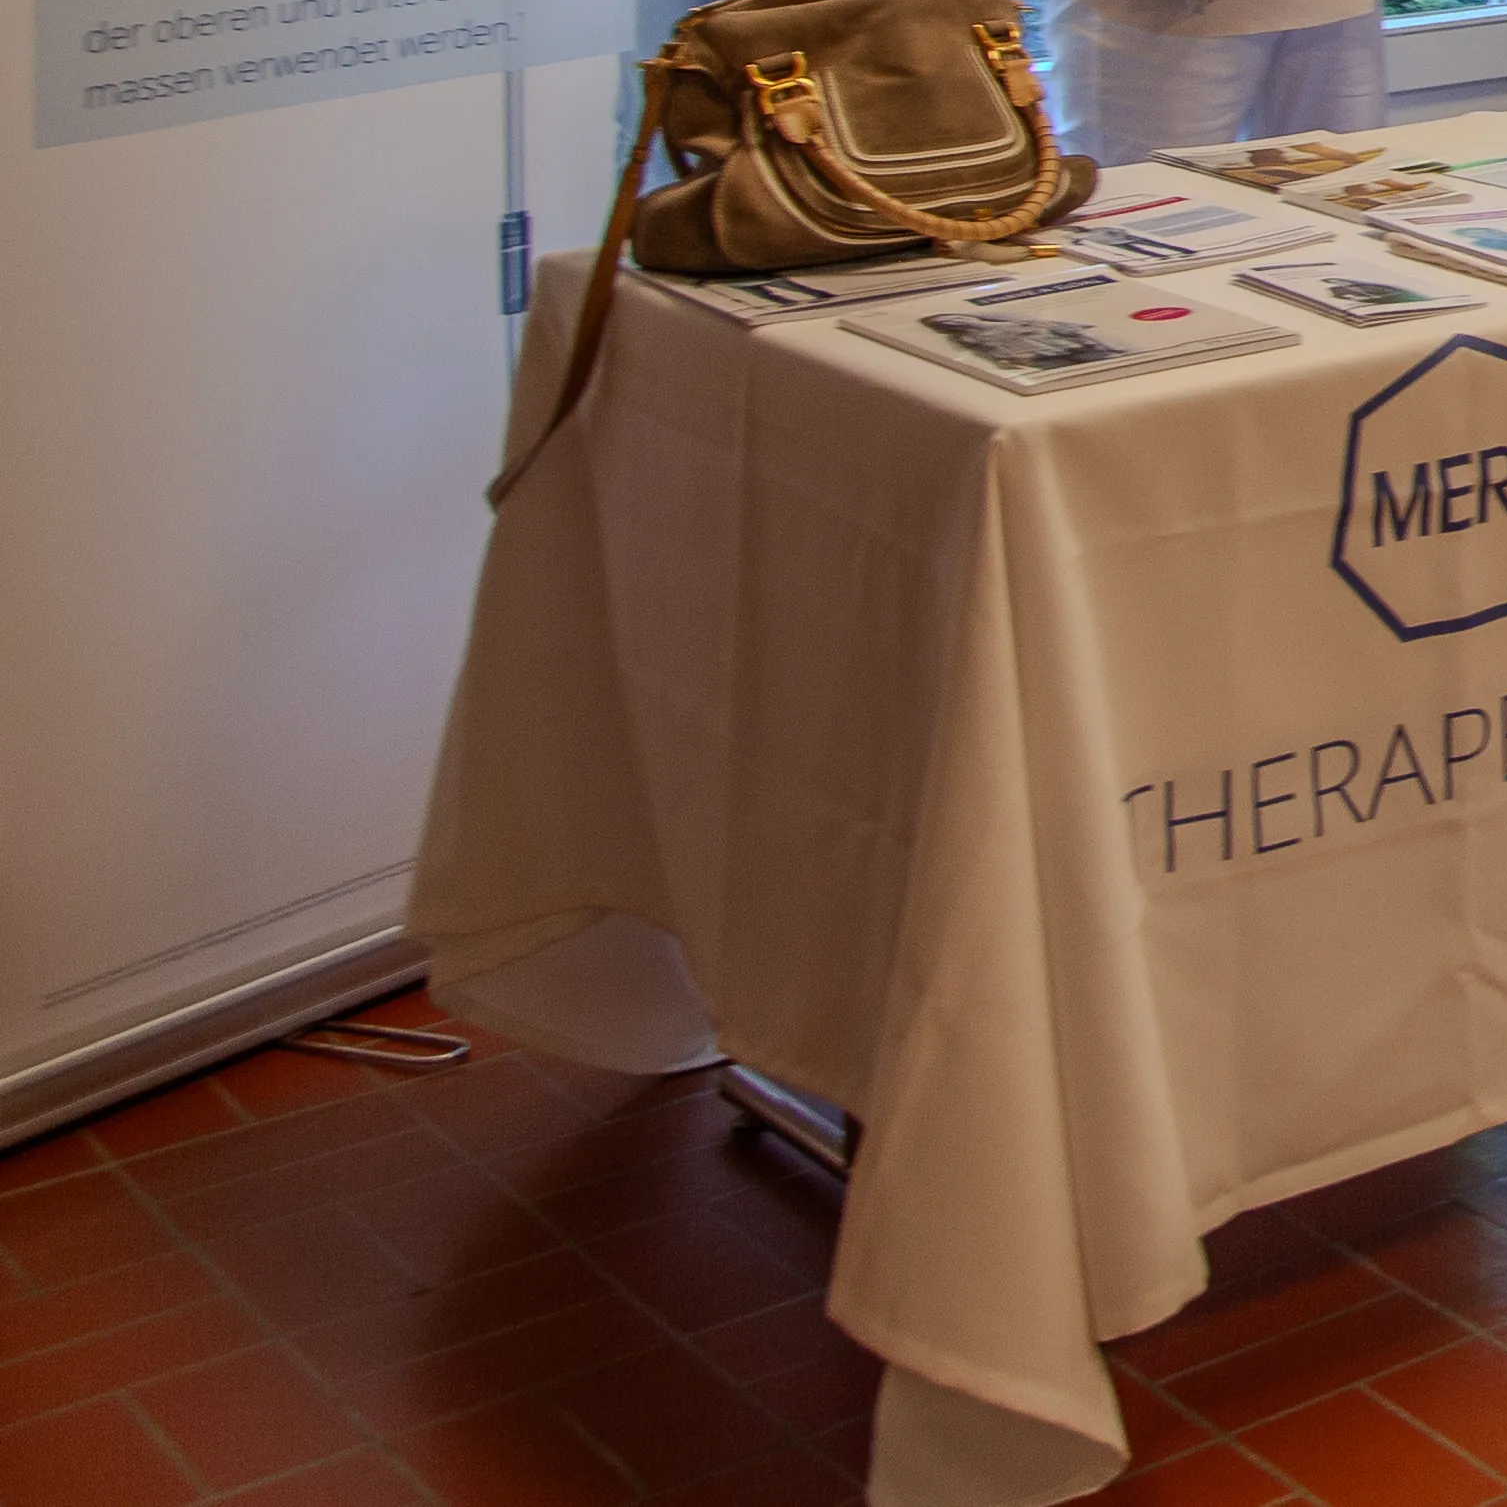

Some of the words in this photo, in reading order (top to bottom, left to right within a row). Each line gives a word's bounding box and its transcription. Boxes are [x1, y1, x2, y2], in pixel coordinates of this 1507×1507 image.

[82, 17, 146, 54] der
[152, 1, 270, 44] oberen
[82, 65, 215, 109] massen
[222, 36, 389, 86] verwendet
